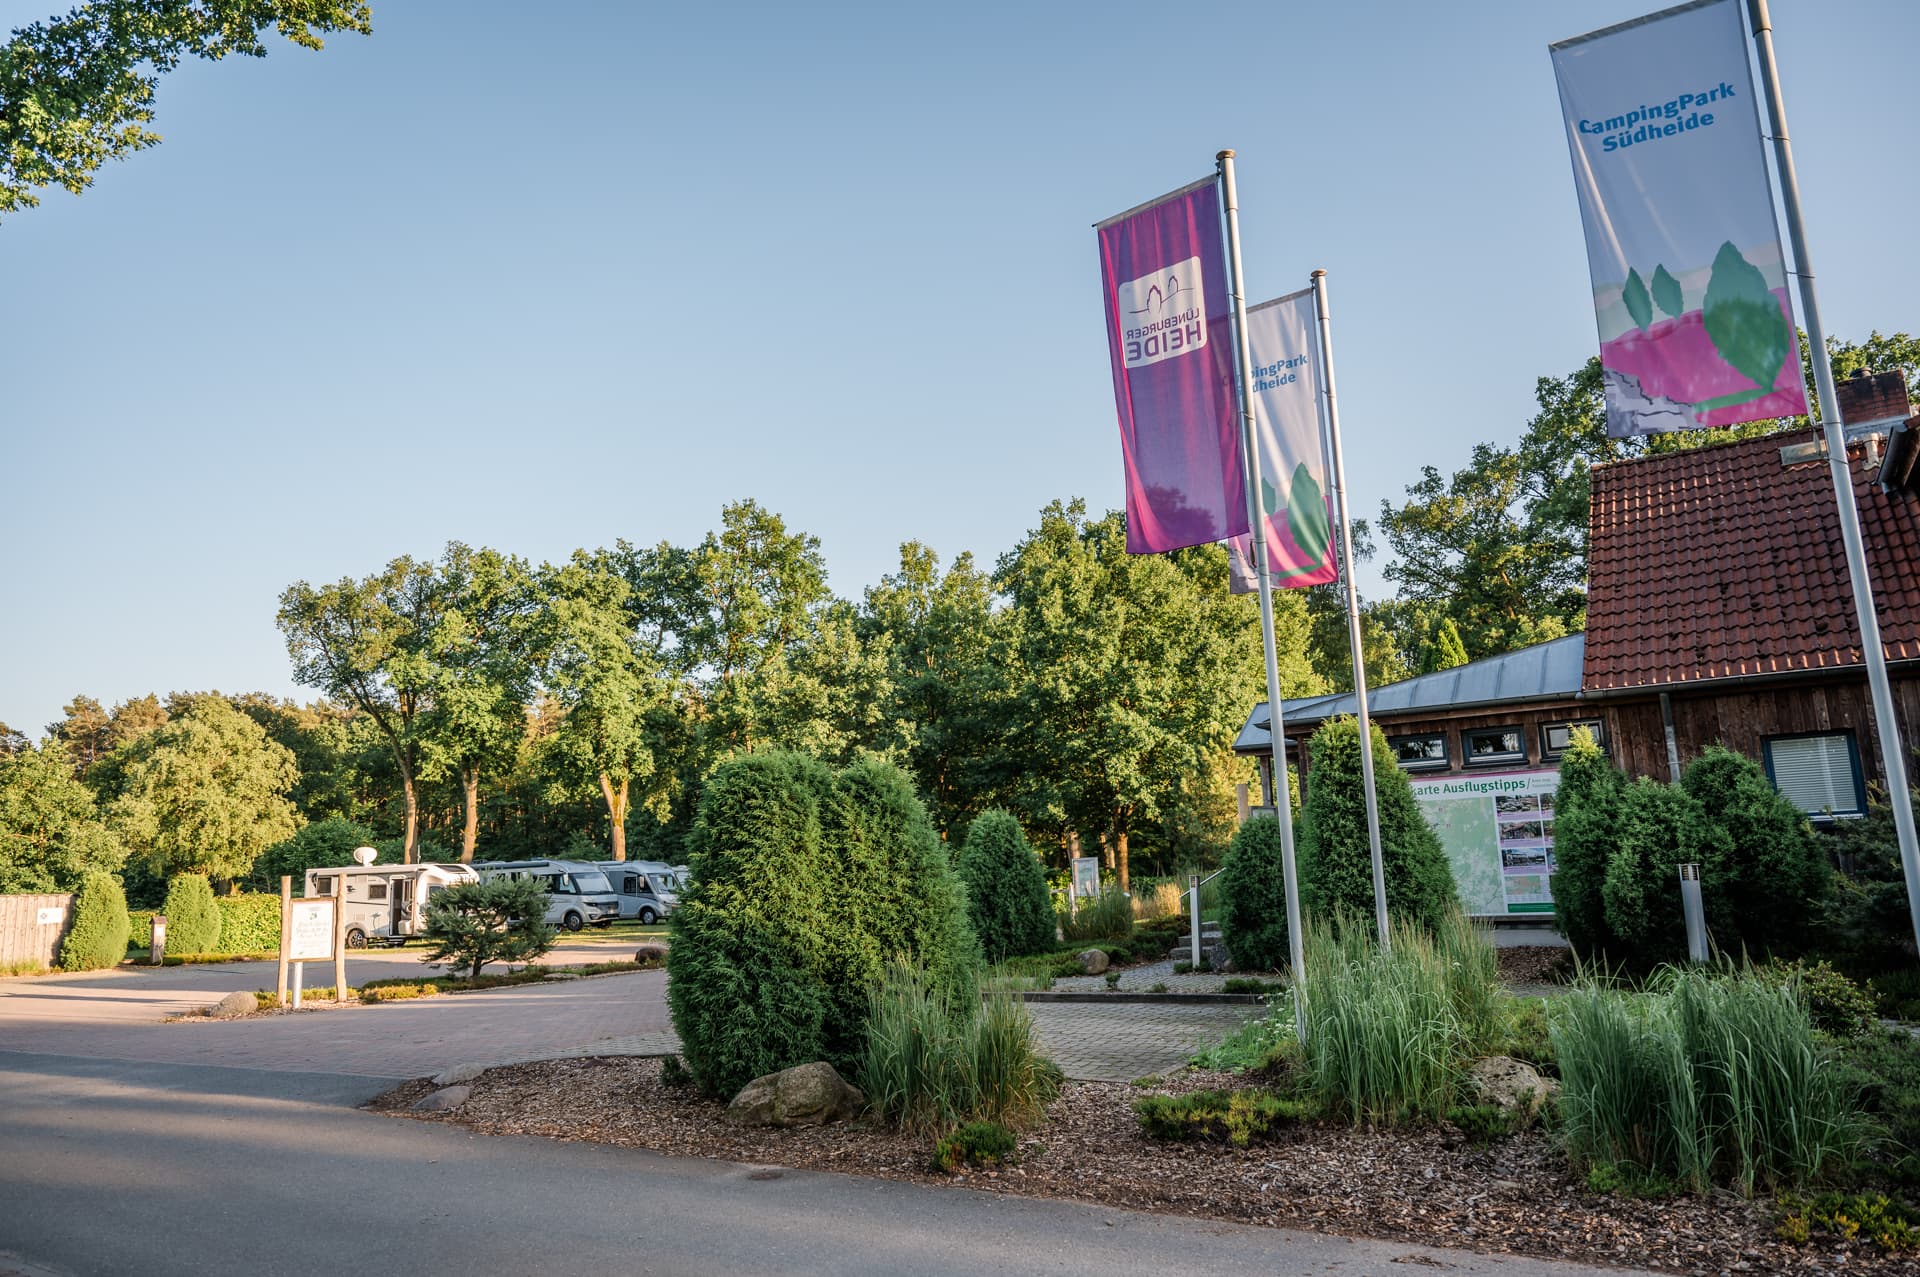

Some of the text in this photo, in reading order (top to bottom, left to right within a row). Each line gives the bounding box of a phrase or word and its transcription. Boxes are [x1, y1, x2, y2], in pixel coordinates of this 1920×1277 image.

[1578, 81, 1736, 135] CampingPark
[1602, 112, 1715, 152] Südheide
[1250, 353, 1308, 379] ingPark
[1252, 373, 1297, 393] dheide
